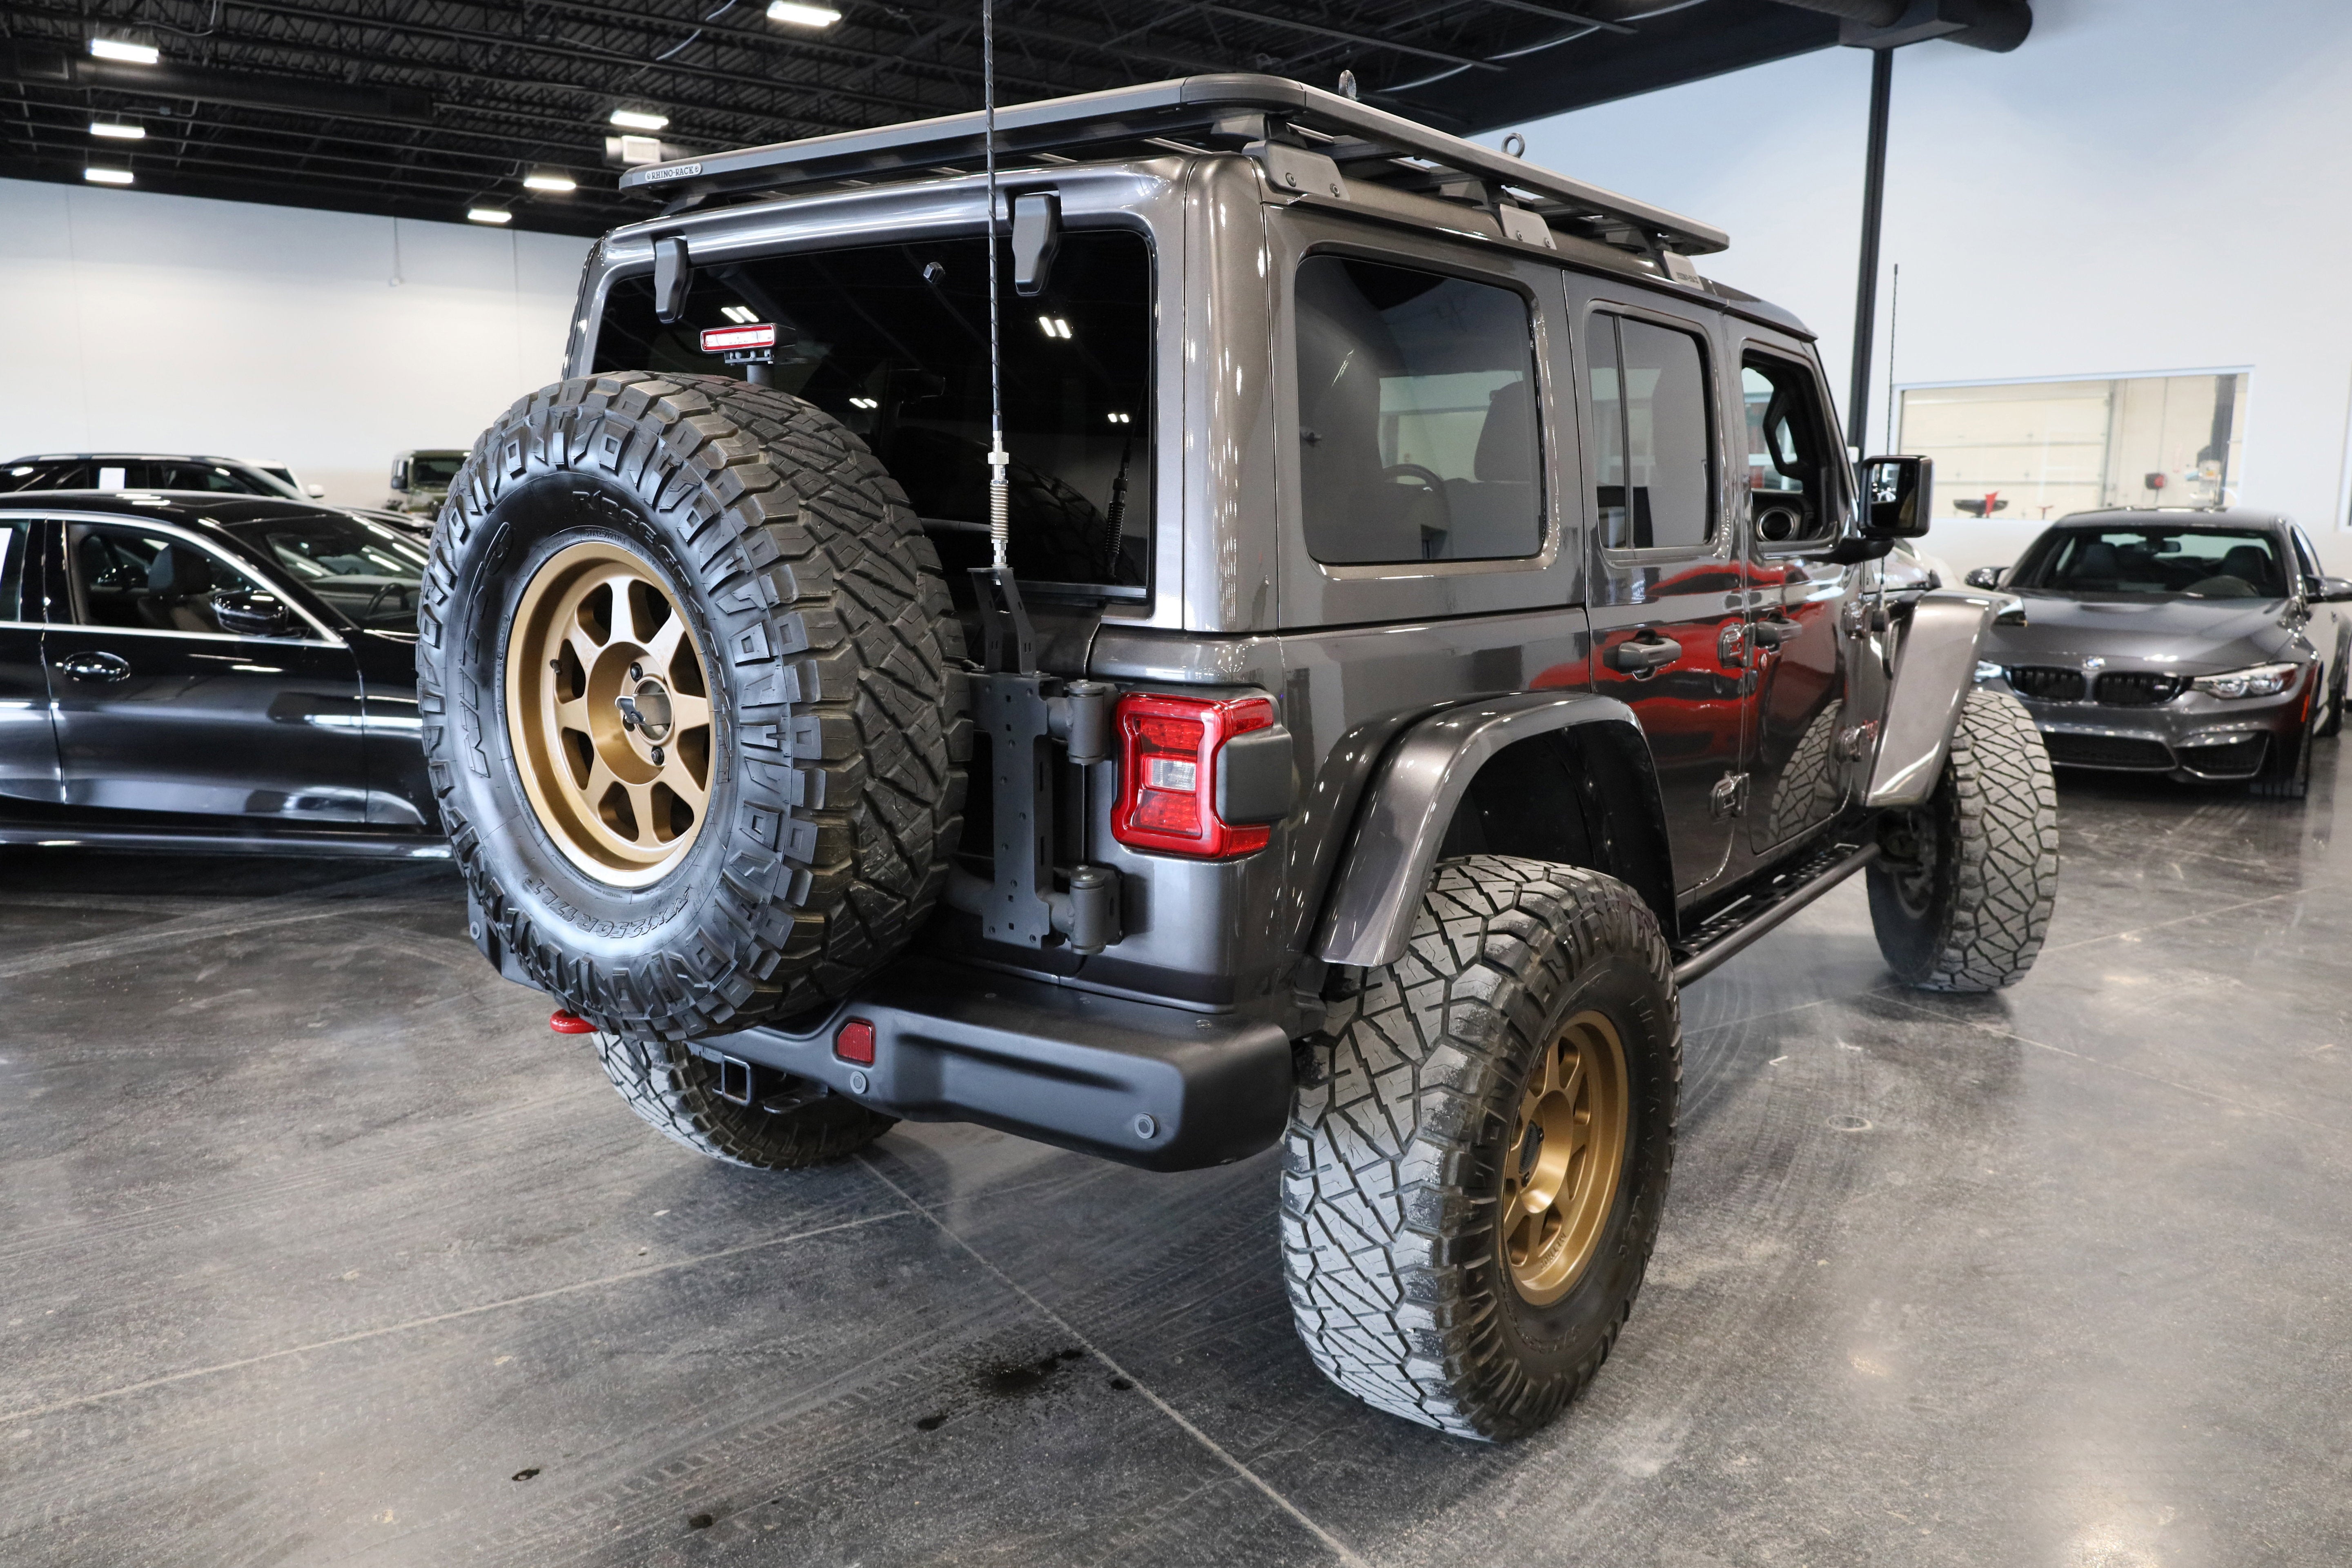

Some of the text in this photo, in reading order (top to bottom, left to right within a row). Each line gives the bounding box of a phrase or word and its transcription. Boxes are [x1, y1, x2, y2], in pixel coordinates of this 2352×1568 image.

[651, 166, 694, 180] RHINO-RACK
[572, 490, 657, 544] RIDGE
[458, 521, 514, 778] NITTO
